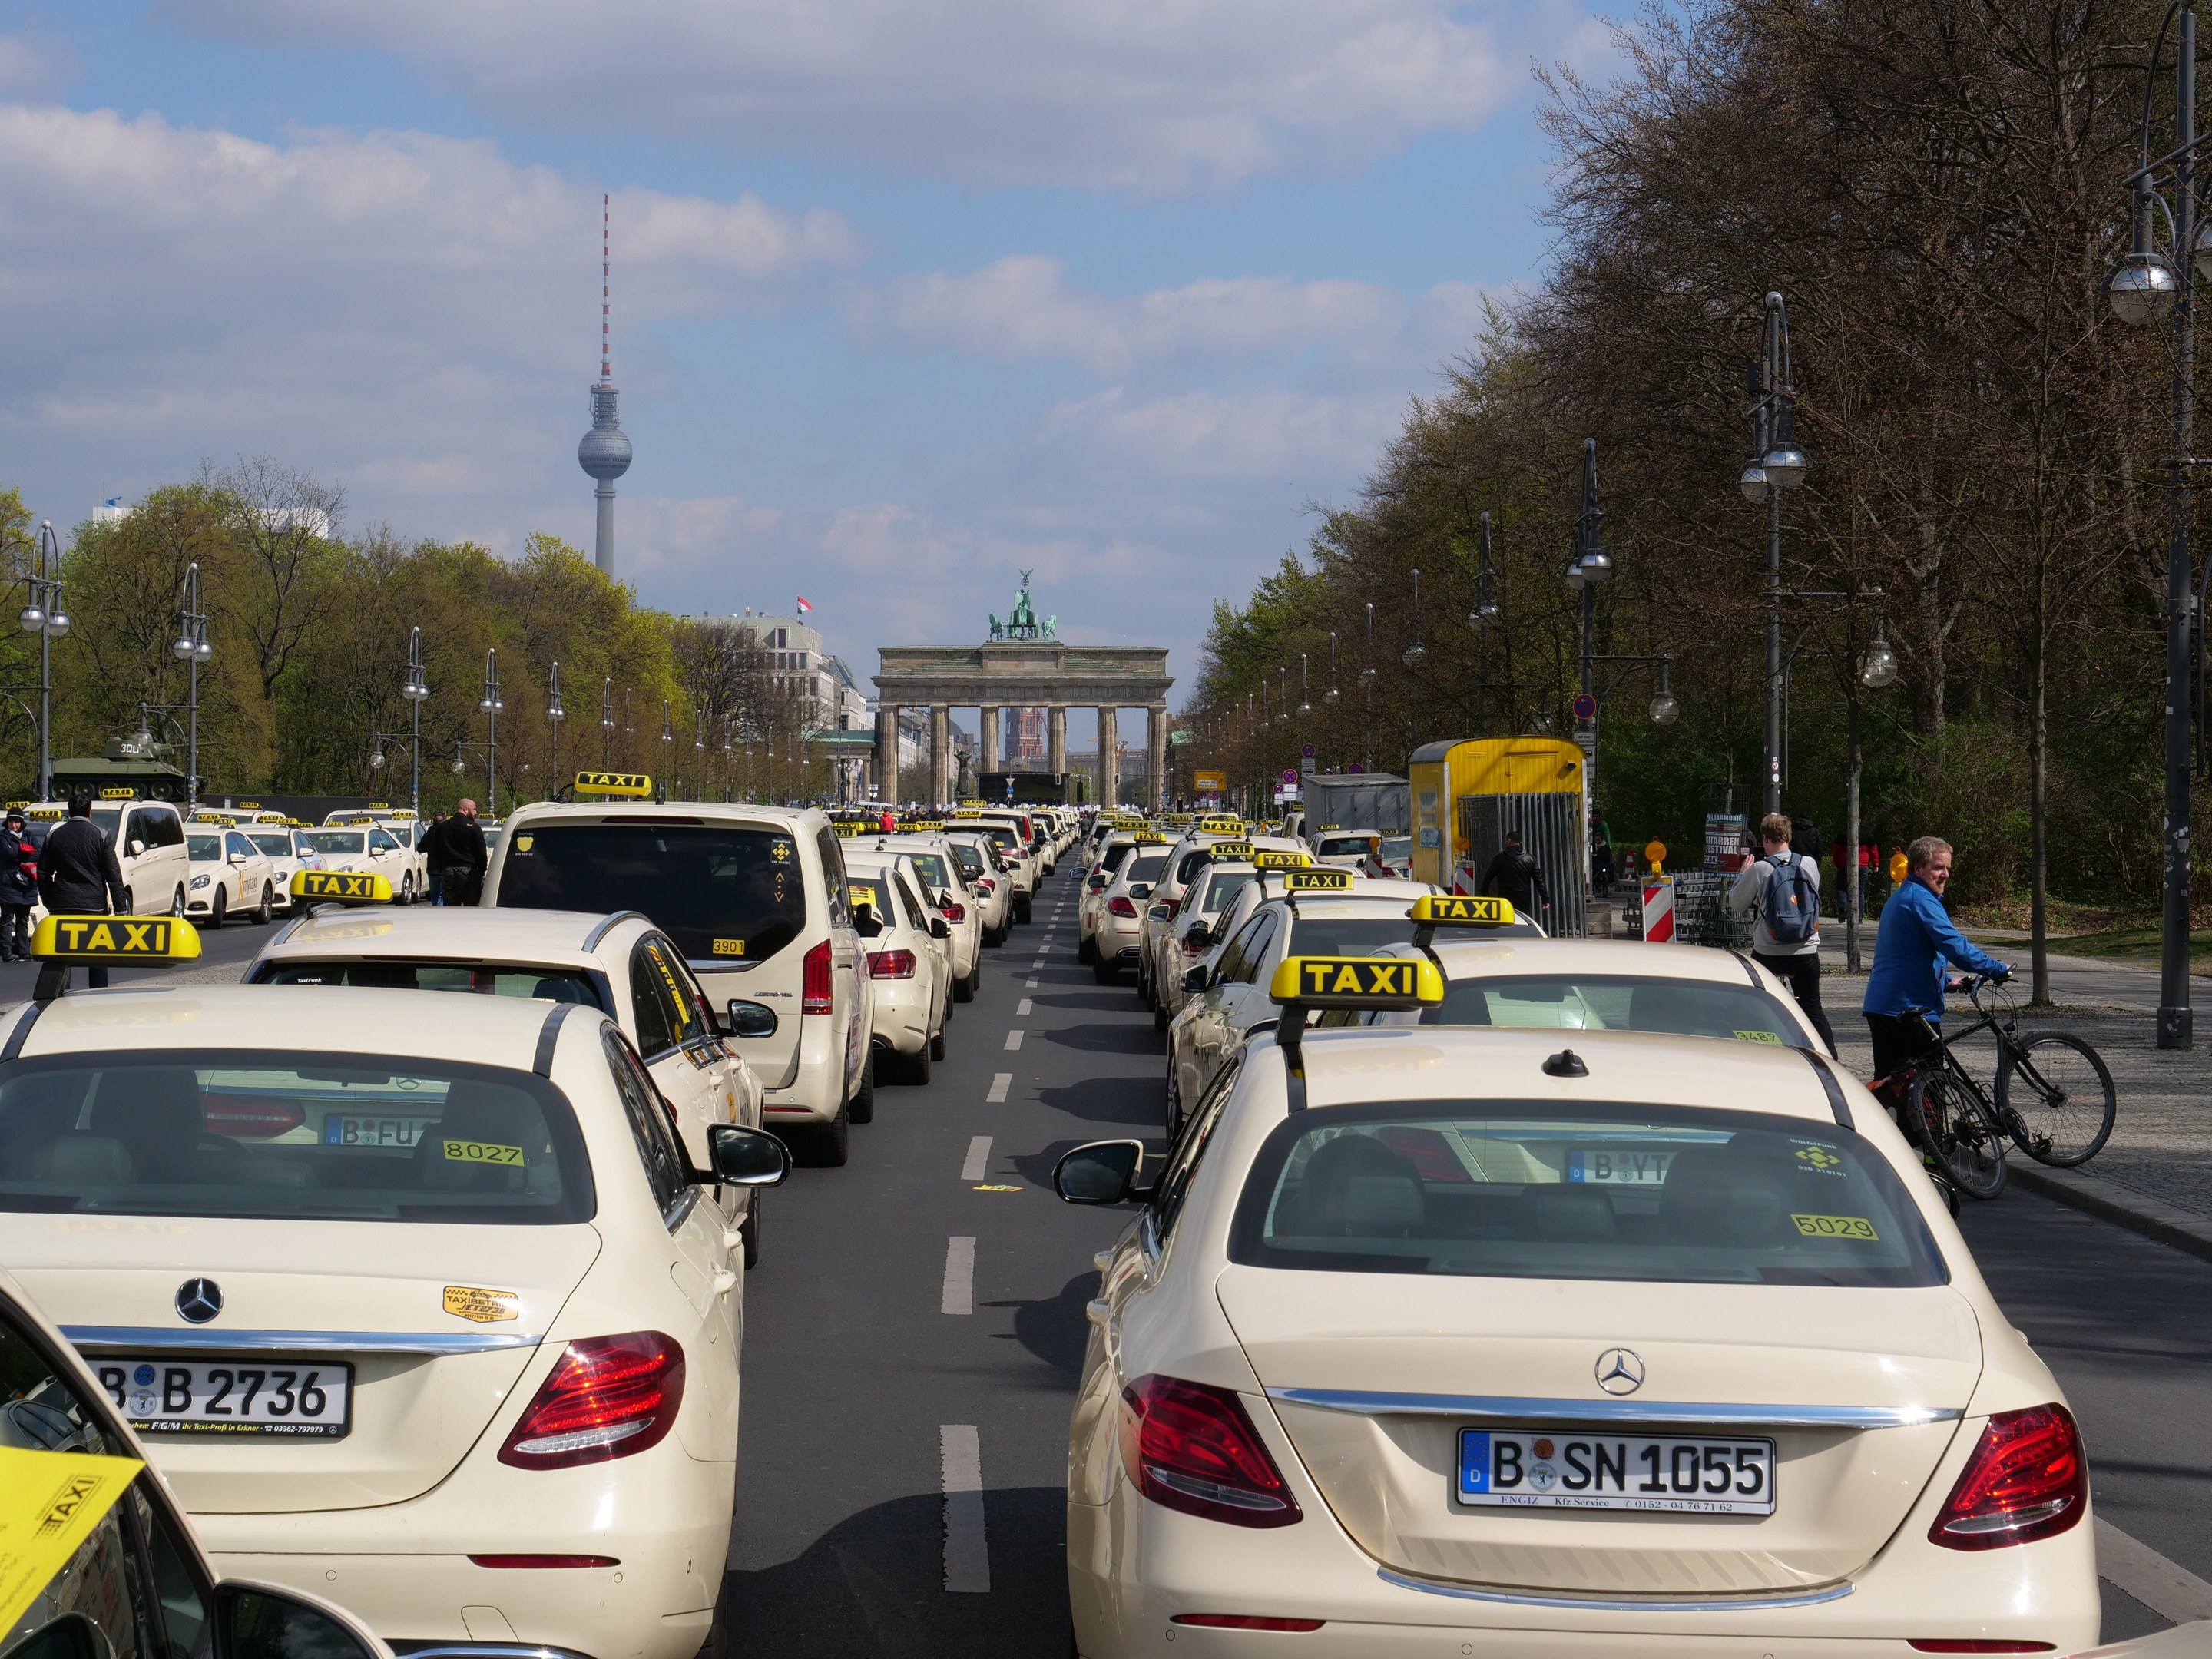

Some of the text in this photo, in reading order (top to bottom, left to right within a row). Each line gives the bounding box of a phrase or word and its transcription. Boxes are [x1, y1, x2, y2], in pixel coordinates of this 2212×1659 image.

[587, 773, 637, 786] TAXI
[1207, 823, 1237, 831] TAXI
[1706, 844, 1737, 855] FESTIVAL
[1265, 855, 1302, 866] TAXI
[308, 876, 372, 896] TAXI
[1299, 876, 1340, 886] TAXI
[1434, 900, 1498, 919] TAXI
[61, 923, 166, 951] TAXI
[714, 941, 744, 953] 3901
[1306, 964, 1412, 995] TAXI
[1737, 1031, 1775, 1041] 3487
[343, 1120, 359, 1144] B
[378, 1121, 413, 1144] FU
[446, 1143, 521, 1163] 8027
[1595, 1154, 1612, 1179] B
[1632, 1154, 1667, 1181] YT
[1816, 1168, 1846, 1177] 210101
[1795, 1217, 1874, 1237] 5029
[100, 1367, 326, 1417] B B 2736
[194, 1423, 227, 1432] Taxi-Profi
[274, 1425, 323, 1433] 03362-797979
[1470, 1441, 1764, 1495] D B SN 1055
[42, 1479, 96, 1526] TAXI
[1501, 1495, 1540, 1505] ENGIZ
[1555, 1498, 1572, 1507] Kfz
[1573, 1498, 1610, 1508] Service
[1634, 1500, 1661, 1510] 0152
[1671, 1502, 1685, 1511] 04
[1687, 1502, 1701, 1512] 76
[1703, 1502, 1717, 1512] 71
[1719, 1503, 1734, 1512] 62
